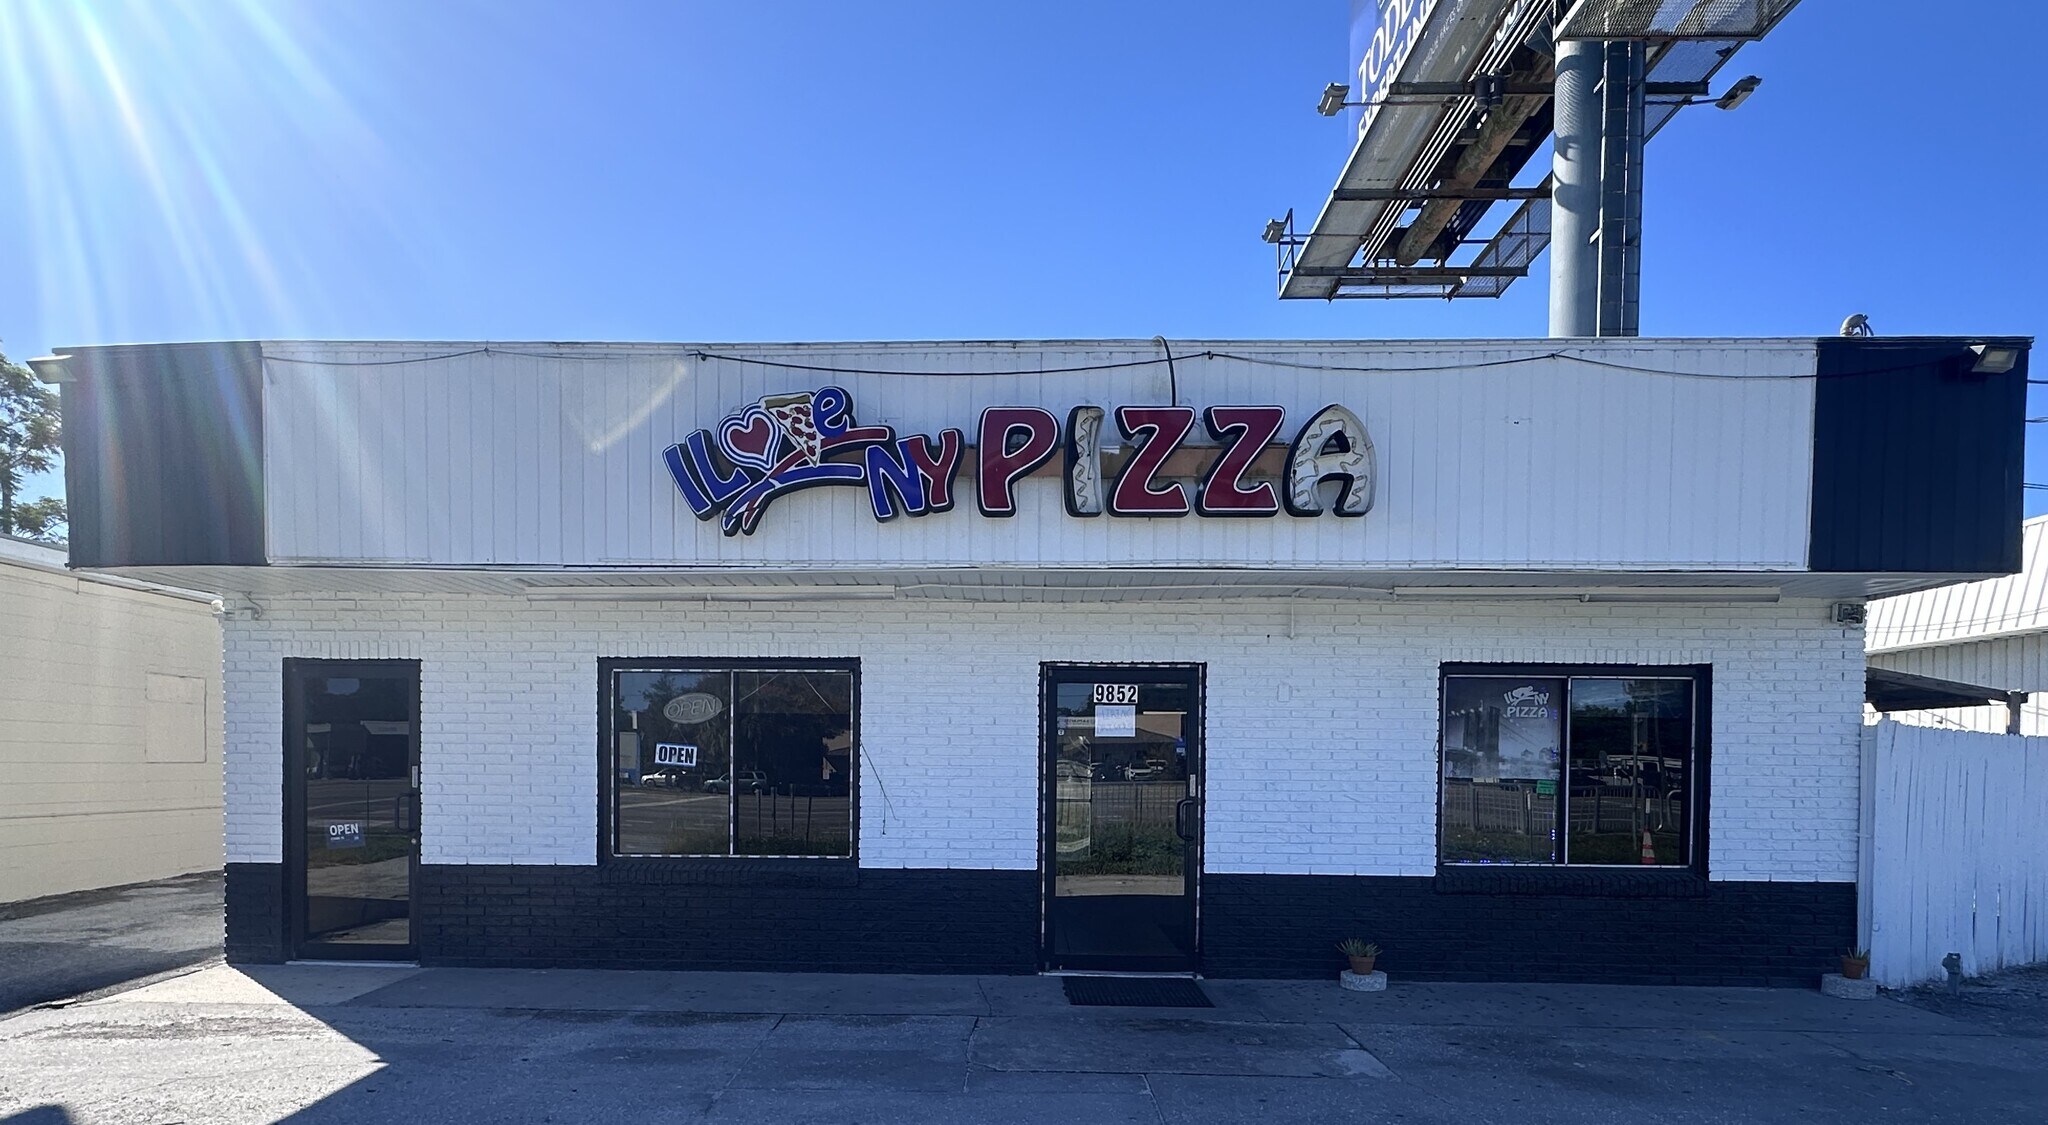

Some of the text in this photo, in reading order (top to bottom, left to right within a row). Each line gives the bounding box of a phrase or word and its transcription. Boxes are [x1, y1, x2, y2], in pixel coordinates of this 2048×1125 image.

[864, 428, 961, 519] NY
[976, 403, 1376, 517] PIZZA
[1095, 684, 1137, 703] 9852
[1534, 692, 1549, 705] NY
[667, 698, 716, 718] OPEN
[1507, 706, 1548, 718] PIZZA
[658, 746, 695, 765] OPEN
[329, 823, 359, 836] OPEN
